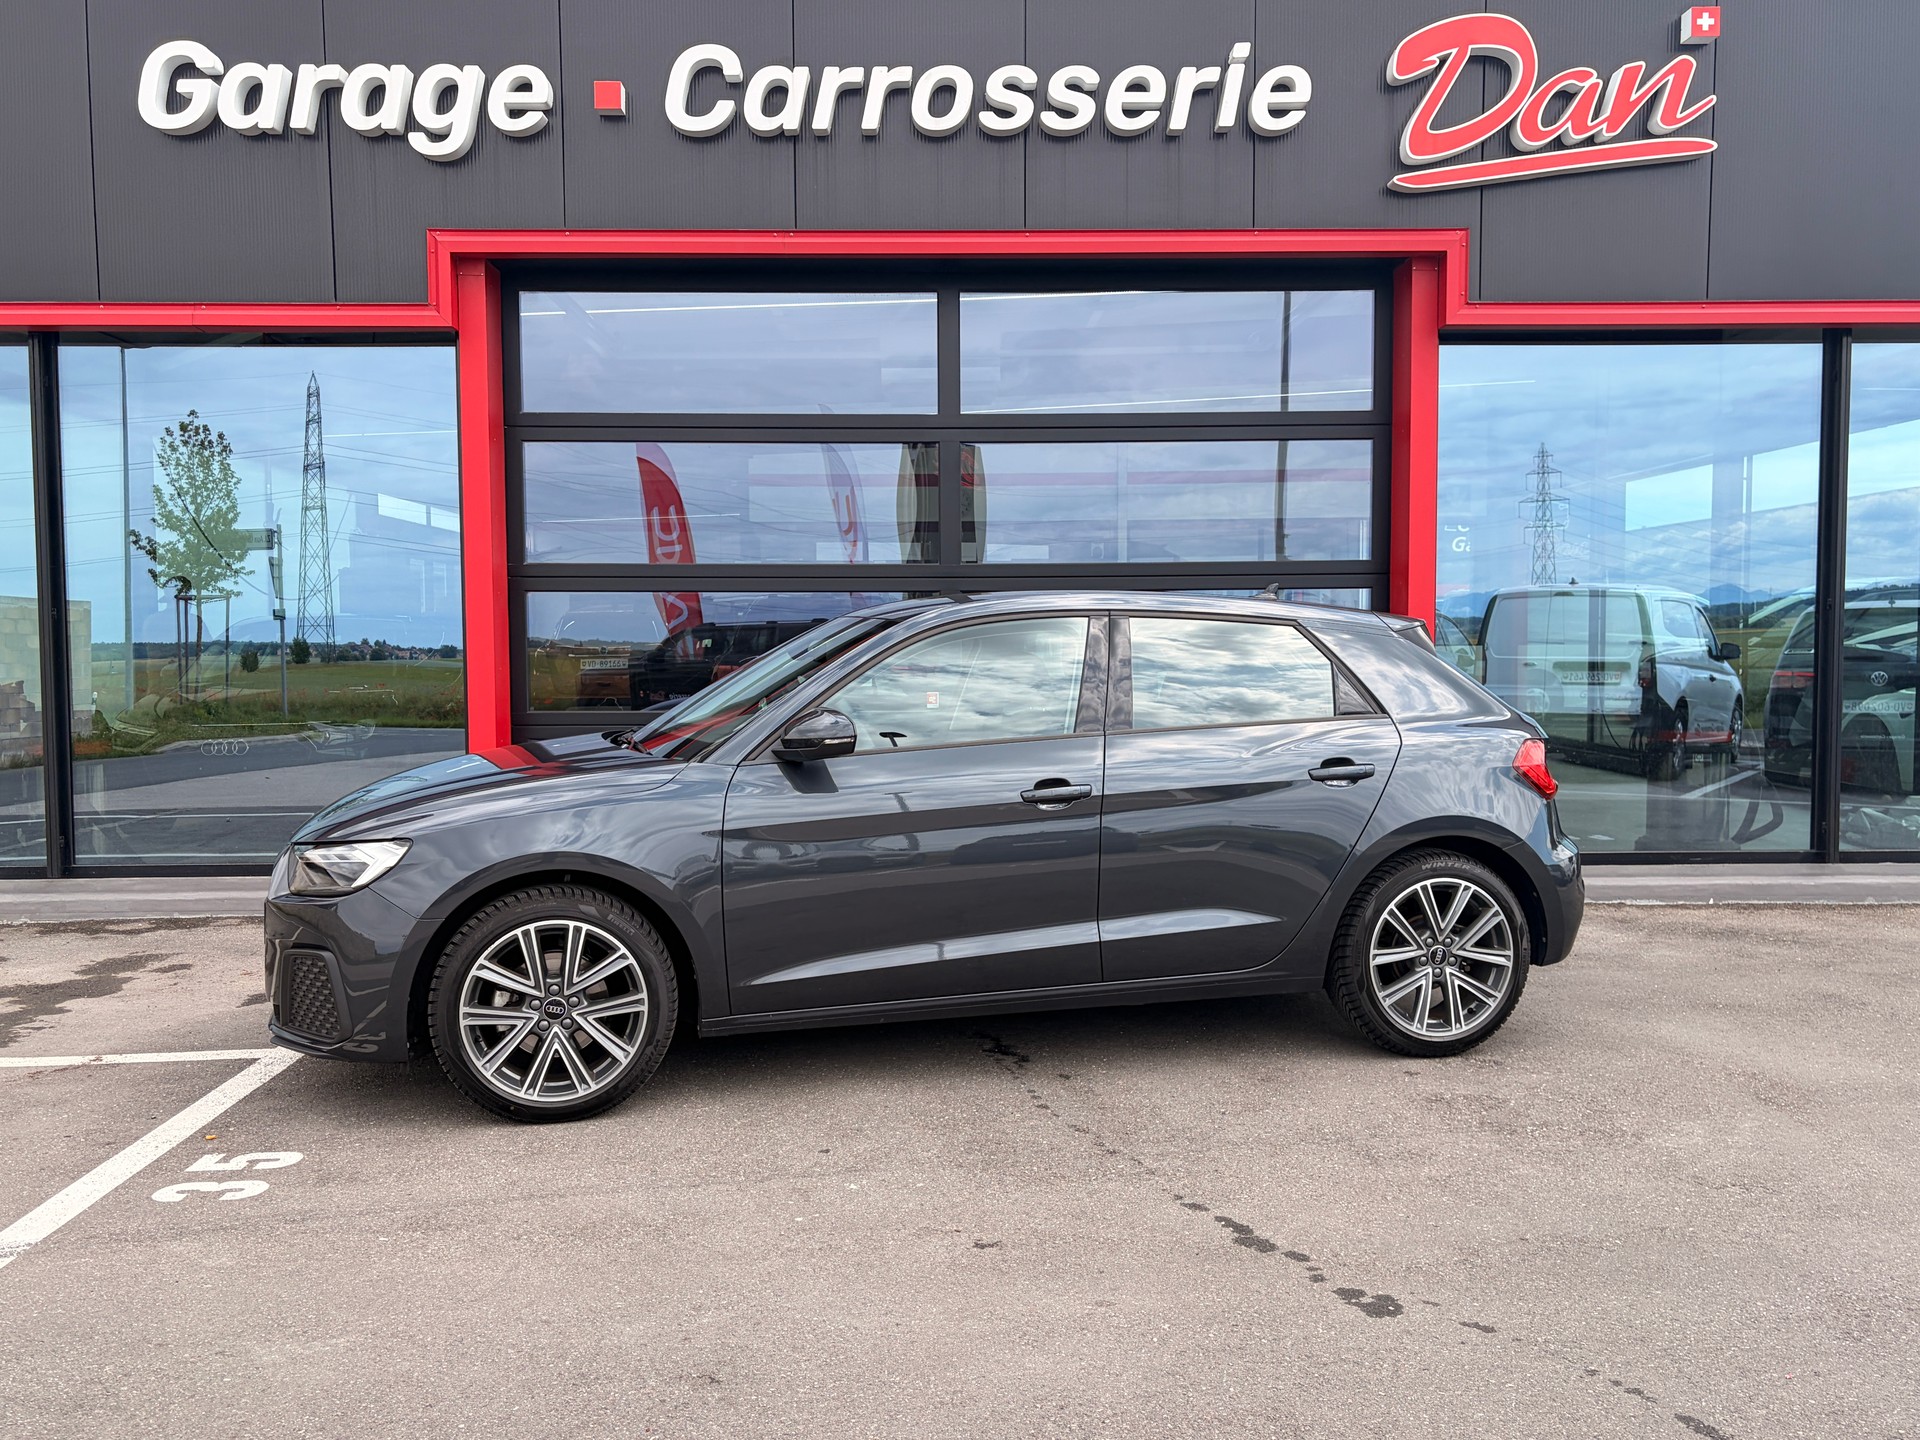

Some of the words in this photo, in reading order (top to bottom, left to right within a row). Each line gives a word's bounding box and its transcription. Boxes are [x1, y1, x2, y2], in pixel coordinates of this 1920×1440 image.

[138, 39, 554, 161] Garage
[665, 41, 1312, 137] Carrosserie
[1421, 861, 1471, 871] WINTER
[151, 1151, 304, 1202] 35
